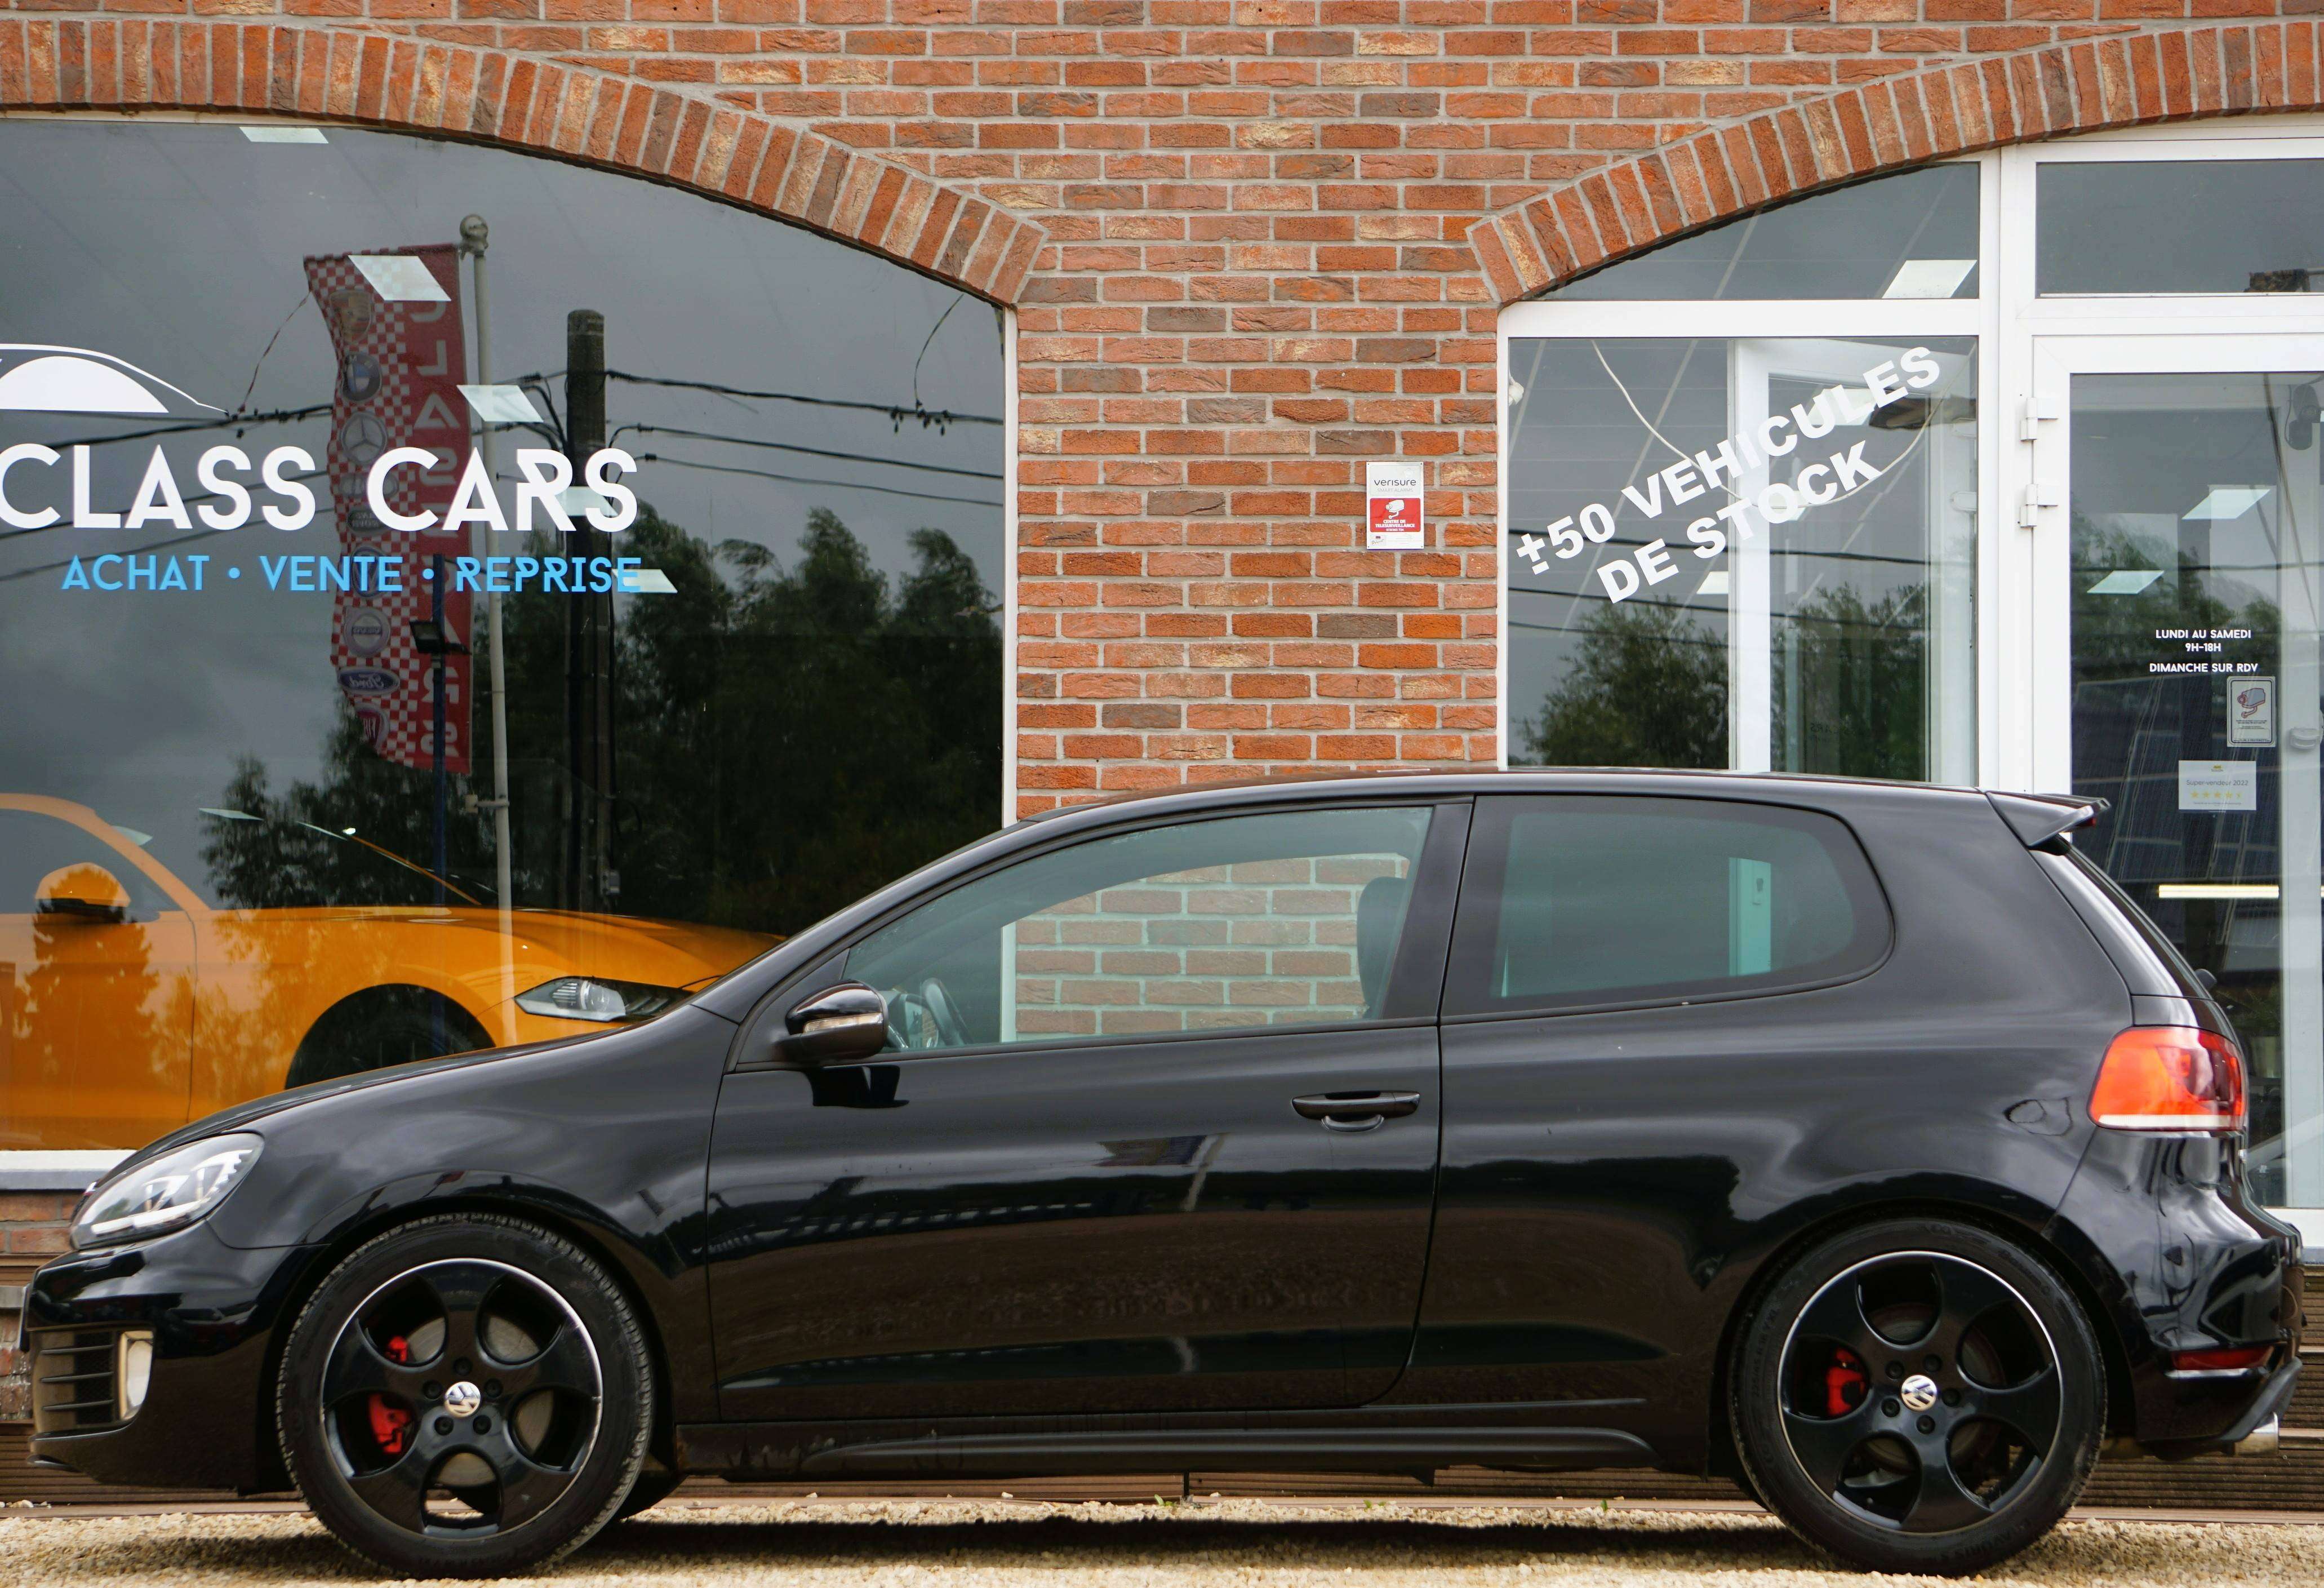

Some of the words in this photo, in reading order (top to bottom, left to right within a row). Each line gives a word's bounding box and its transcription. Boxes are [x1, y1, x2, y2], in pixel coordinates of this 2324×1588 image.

[1621, 346, 1940, 519] VEHICULES
[0, 443, 316, 530] CLASS
[367, 446, 638, 532] CARS
[1597, 538, 1679, 604] DE
[1685, 440, 1883, 560] STOCK
[61, 554, 210, 591] ACHAT
[259, 555, 403, 592] VENTE
[456, 556, 642, 593] REPRISE
[2156, 629, 2188, 638] LUNDI
[2192, 629, 2206, 638] AU
[2210, 629, 2251, 639] SAMEDI
[2185, 642, 2221, 652] 9H-18H
[2149, 663, 2208, 672] DIMANCHE
[2211, 663, 2233, 672] SUR
[2237, 663, 2258, 672] RDV
